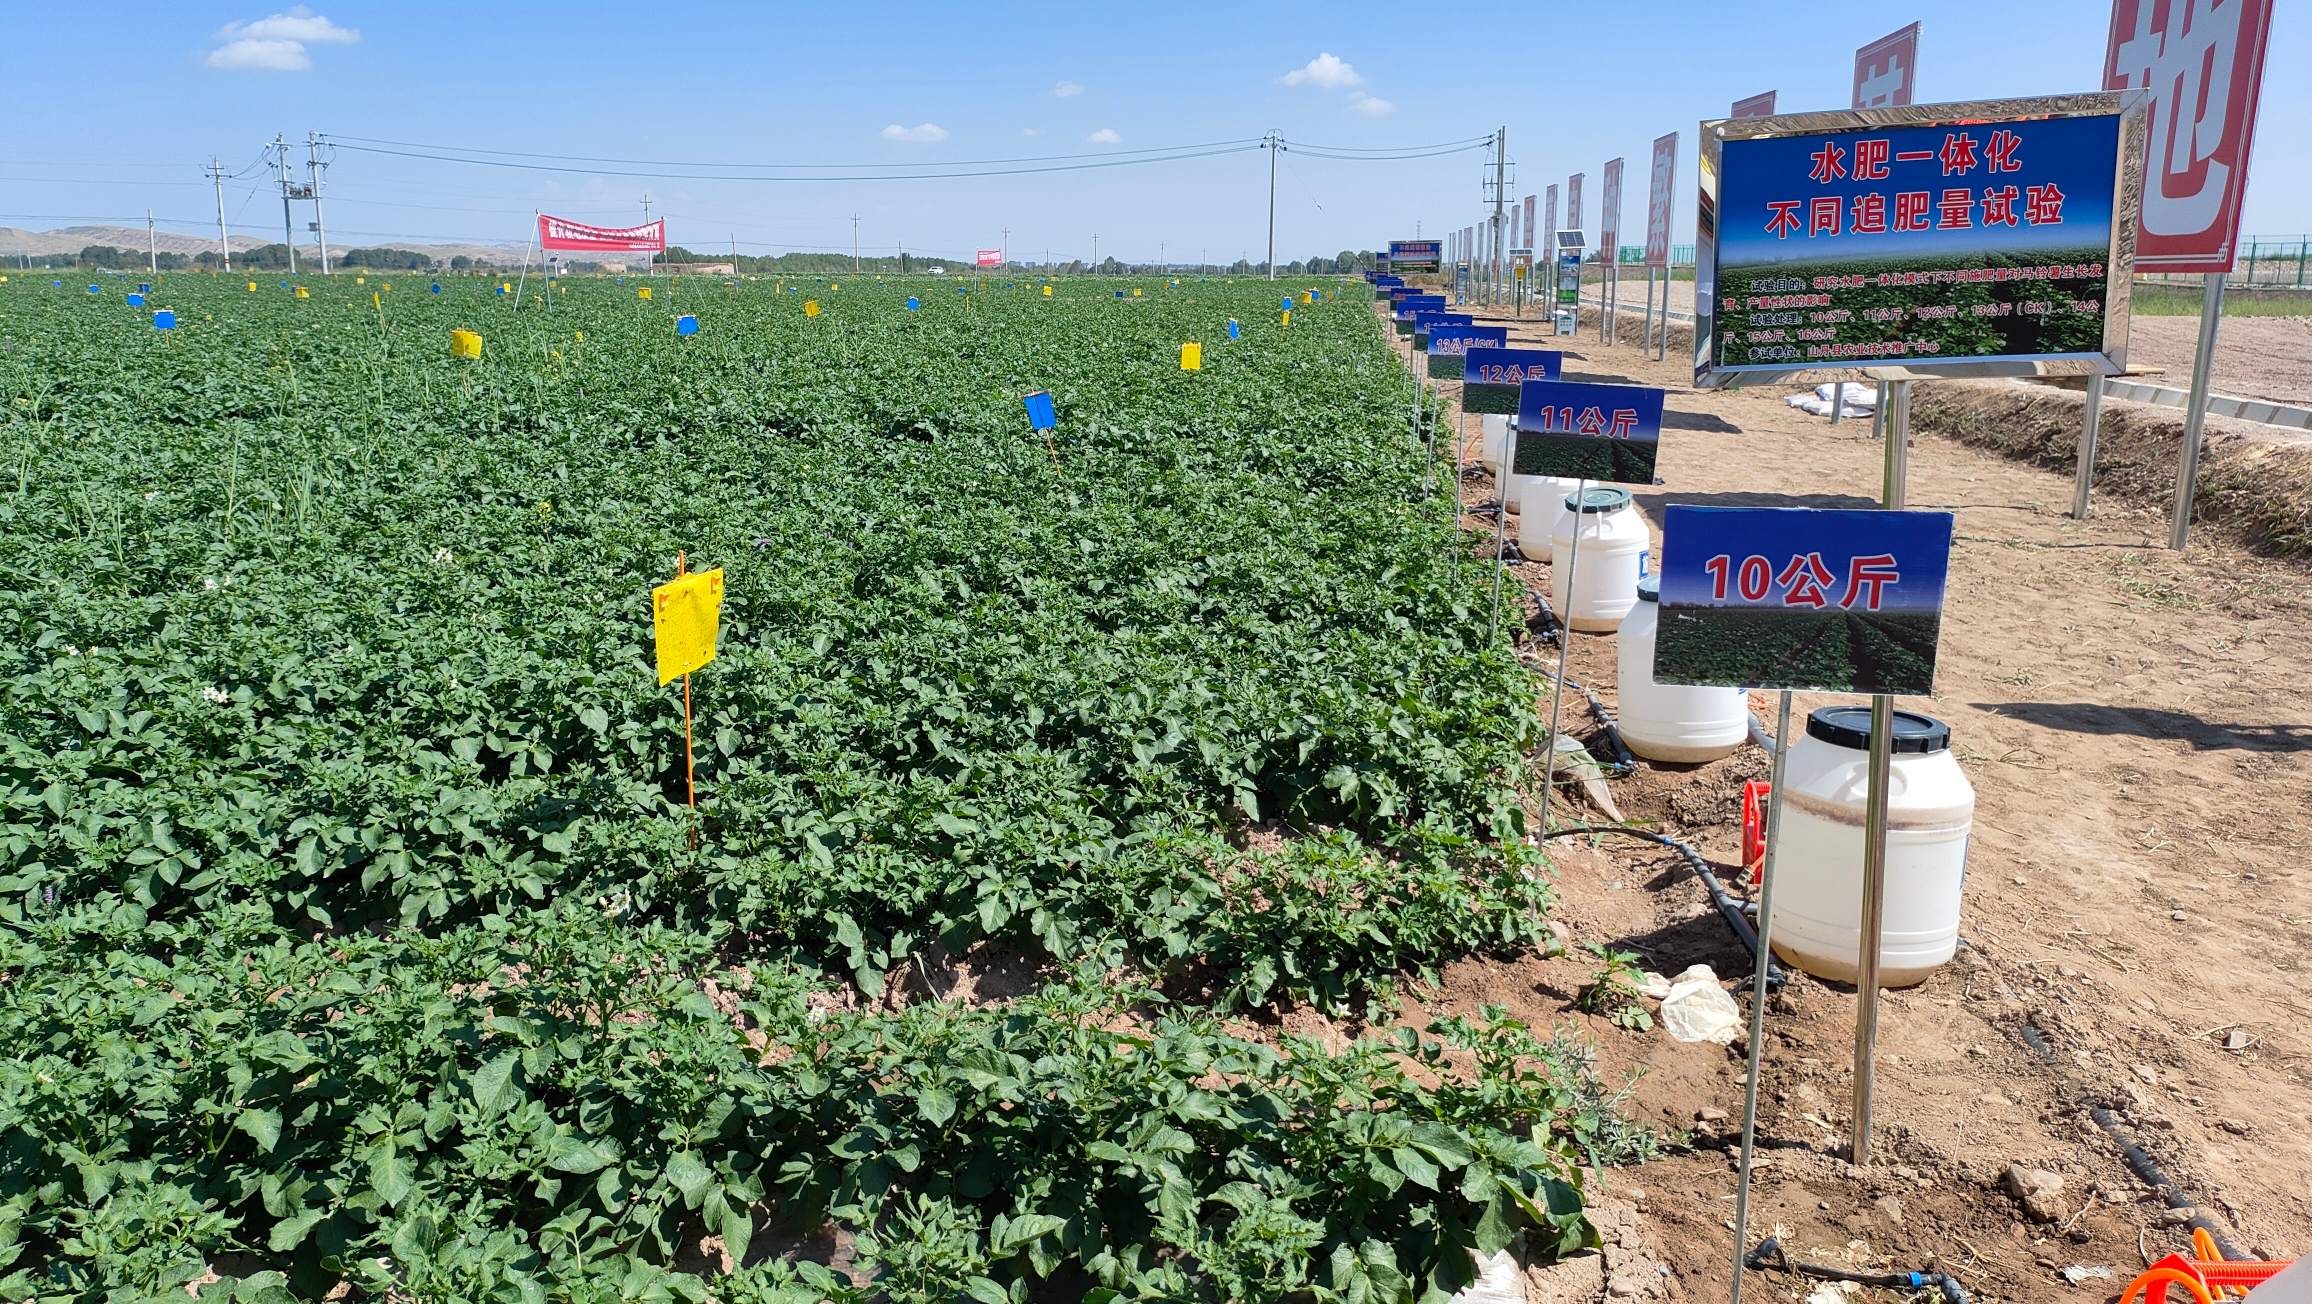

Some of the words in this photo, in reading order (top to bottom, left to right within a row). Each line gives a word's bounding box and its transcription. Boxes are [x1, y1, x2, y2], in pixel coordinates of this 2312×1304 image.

[1808, 129, 2023, 184] 水肥一体化
[1763, 182, 2066, 240] 不同追肥量试验
[1722, 294, 1830, 312] 育、产量性状的影响
[1479, 363, 1546, 385] 12公斤
[1540, 405, 1639, 439] 11公斤
[1705, 551, 1900, 612] 10公斤
